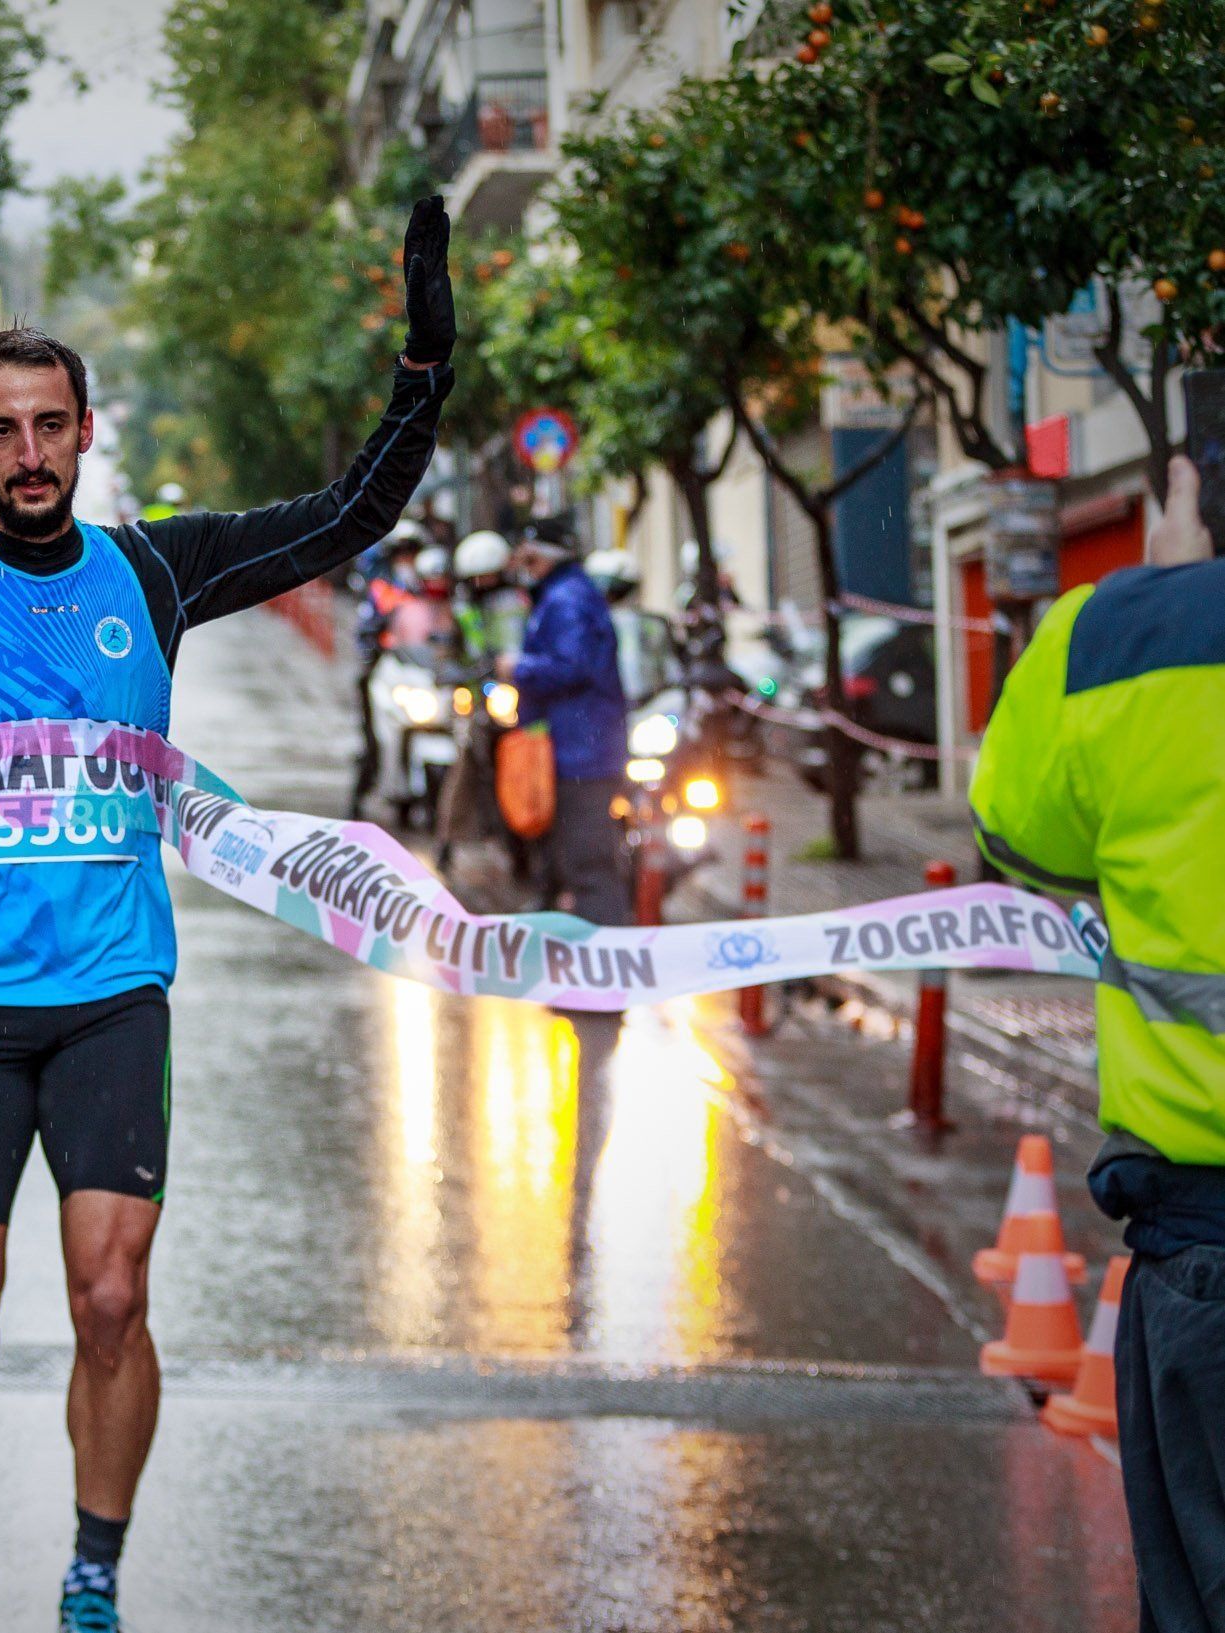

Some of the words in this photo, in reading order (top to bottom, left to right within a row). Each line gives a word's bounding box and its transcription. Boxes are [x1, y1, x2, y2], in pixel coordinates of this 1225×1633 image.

[270, 829, 422, 943] ZOGRAFOU
[425, 912, 527, 978] CITY
[544, 937, 656, 988] RUN
